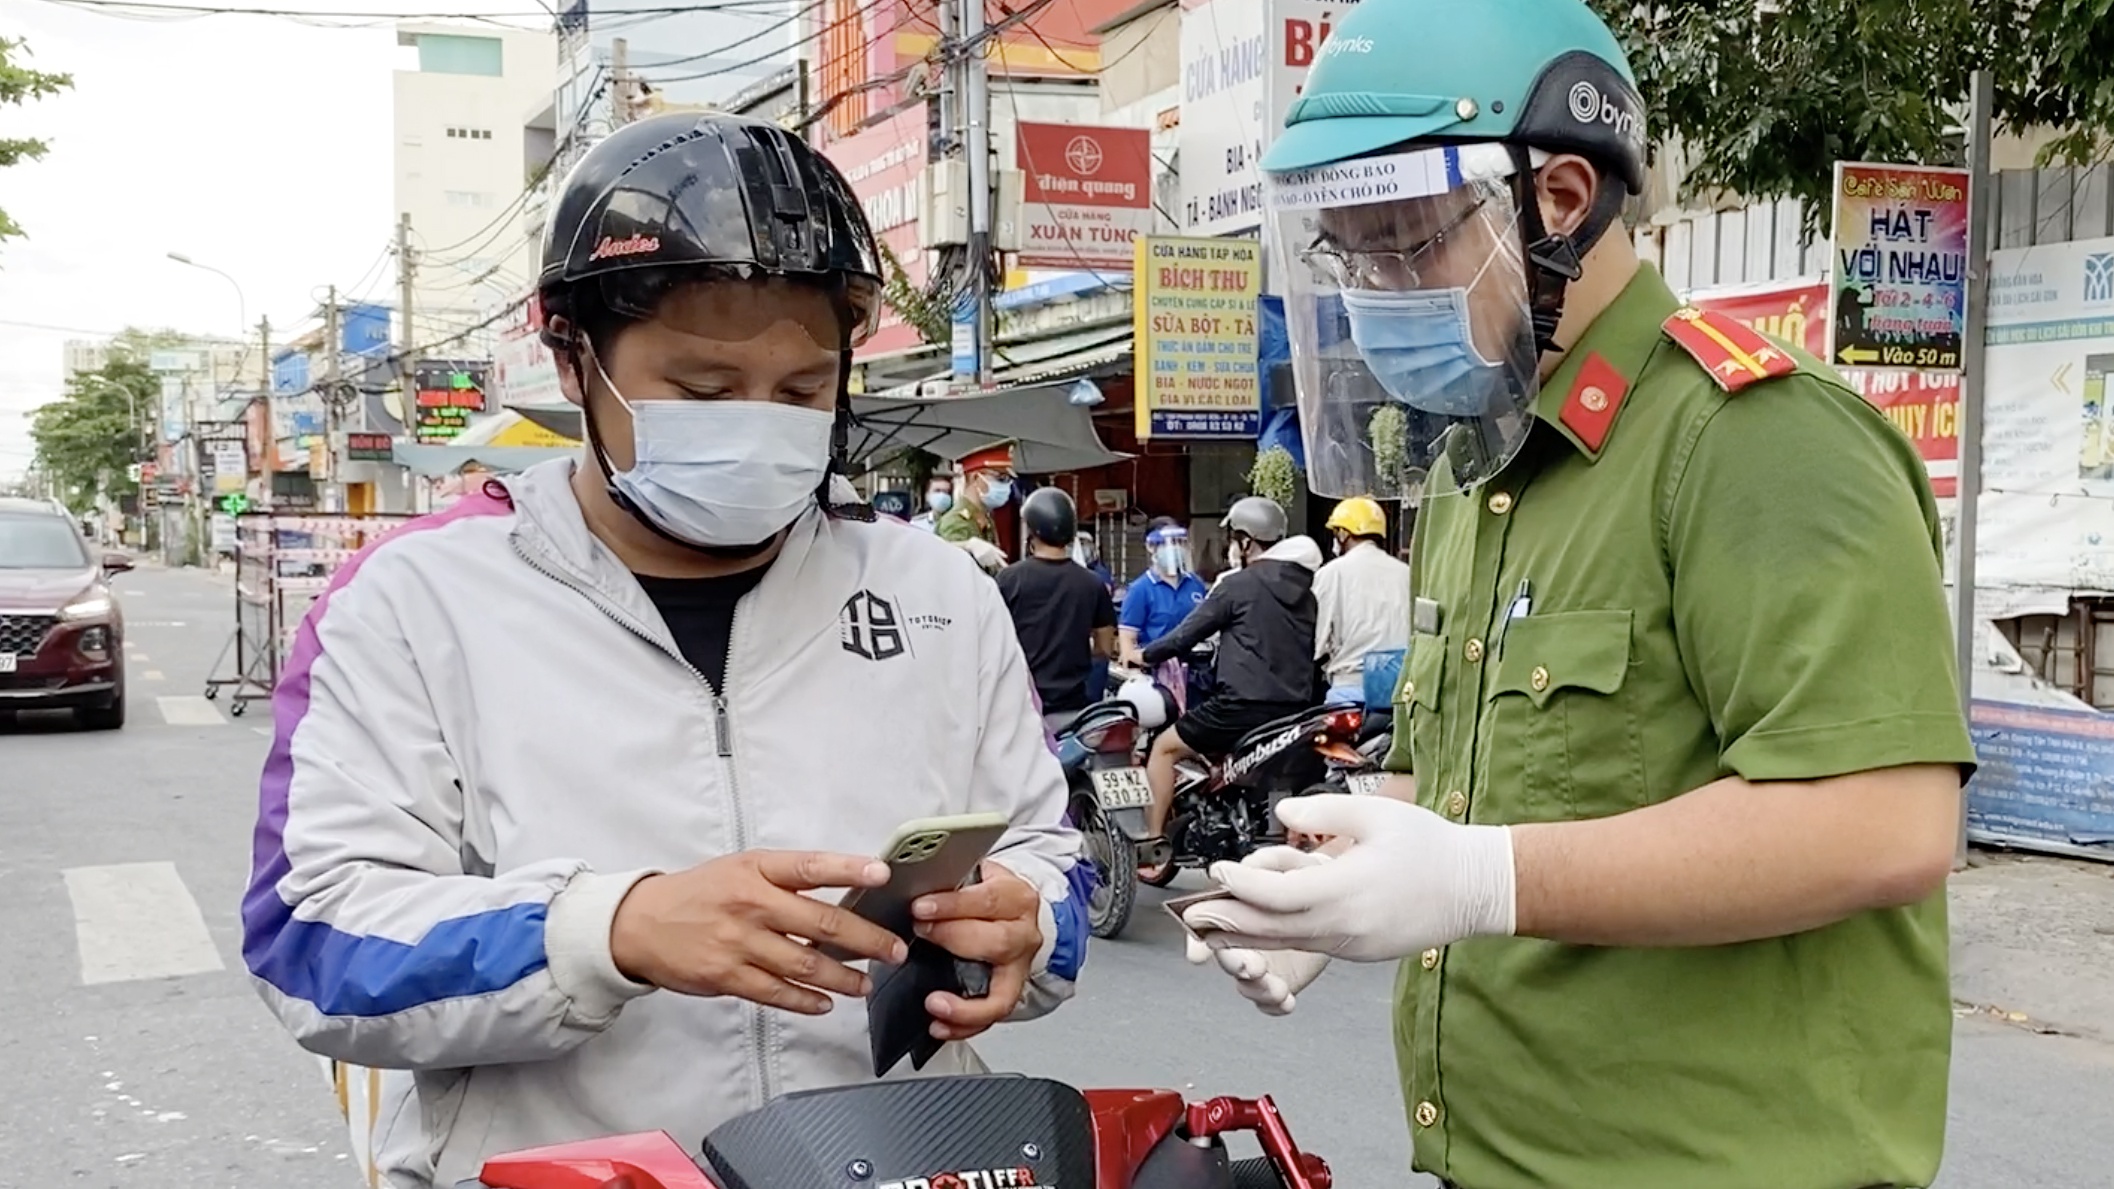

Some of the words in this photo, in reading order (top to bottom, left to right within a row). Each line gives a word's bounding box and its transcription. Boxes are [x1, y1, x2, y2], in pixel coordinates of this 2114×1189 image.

[1328, 34, 1375, 57] bynks
[1030, 223, 1082, 241] XUÂN
[1870, 203, 1933, 242] HÁT
[1890, 252, 1960, 283] NHAU
[1882, 346, 1915, 366] Vào
[1916, 347, 1938, 366] 50
[1939, 351, 1956, 366] m
[1223, 725, 1301, 785] Hayabusa
[1101, 769, 1143, 789] 59-N2
